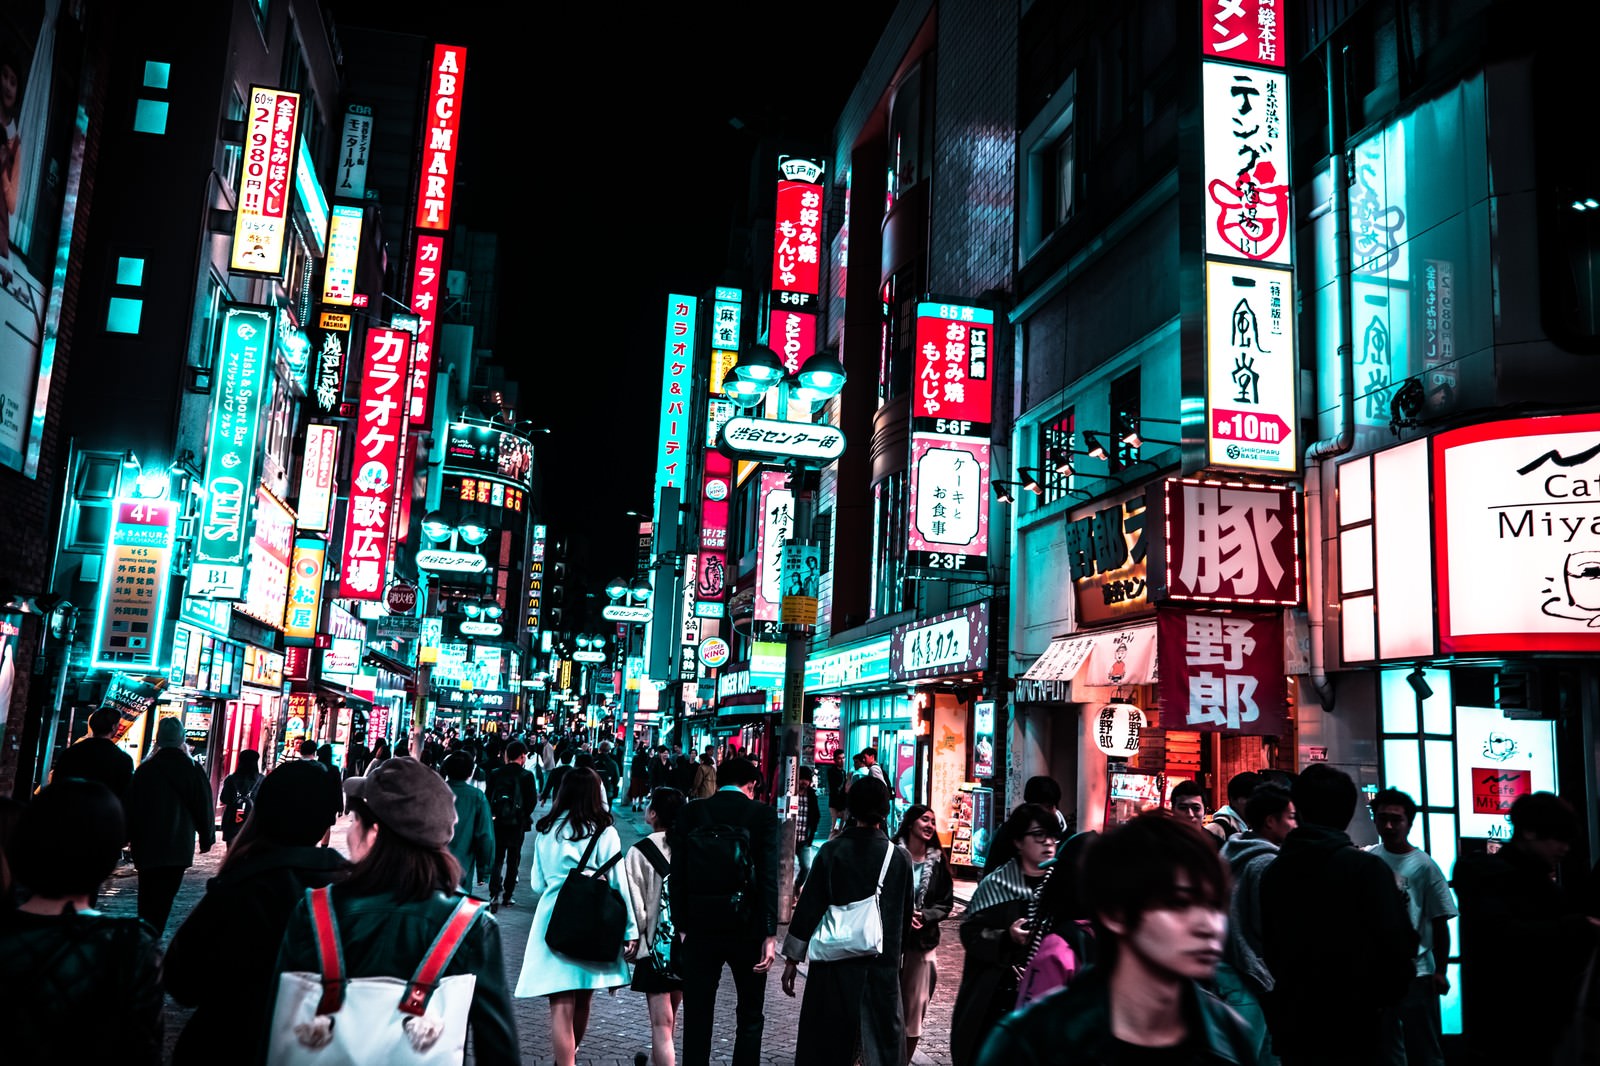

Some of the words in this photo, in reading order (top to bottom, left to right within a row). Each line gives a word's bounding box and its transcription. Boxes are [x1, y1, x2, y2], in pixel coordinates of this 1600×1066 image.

[1257, 0, 1276, 61] 総本店
[268, 98, 294, 214] 全身もみほぐし
[798, 190, 820, 264] お好み焼
[778, 220, 797, 286] もんじゃ
[353, 296, 368, 305] 4F
[322, 321, 347, 329] FASHION
[720, 308, 735, 341] 麻雀
[1231, 275, 1271, 405] 一風堂
[242, 346, 257, 377] Irish
[921, 341, 941, 415] もんじゃ
[944, 322, 966, 404] お好み焼
[236, 389, 252, 423] Sport
[361, 331, 404, 458] カラオケ
[234, 426, 248, 446] Bar
[730, 425, 837, 449] 渋谷センター街
[1218, 413, 1279, 441] 約10m
[953, 458, 965, 519] ケーキと
[130, 504, 158, 522] 4F
[931, 486, 947, 535] お食事
[128, 530, 169, 538] SAKURA
[346, 495, 387, 594] 歌広場
[1179, 486, 1284, 595] 豚
[208, 570, 227, 583] B1
[292, 586, 315, 628] 松屋
[389, 592, 414, 605] 消火栓
[704, 649, 725, 660] KING
[911, 630, 959, 667] 椿屋カフェ
[1185, 614, 1260, 729] 野郎
[1100, 708, 1116, 749] 豚野郎
[1489, 784, 1515, 795] Cafe
